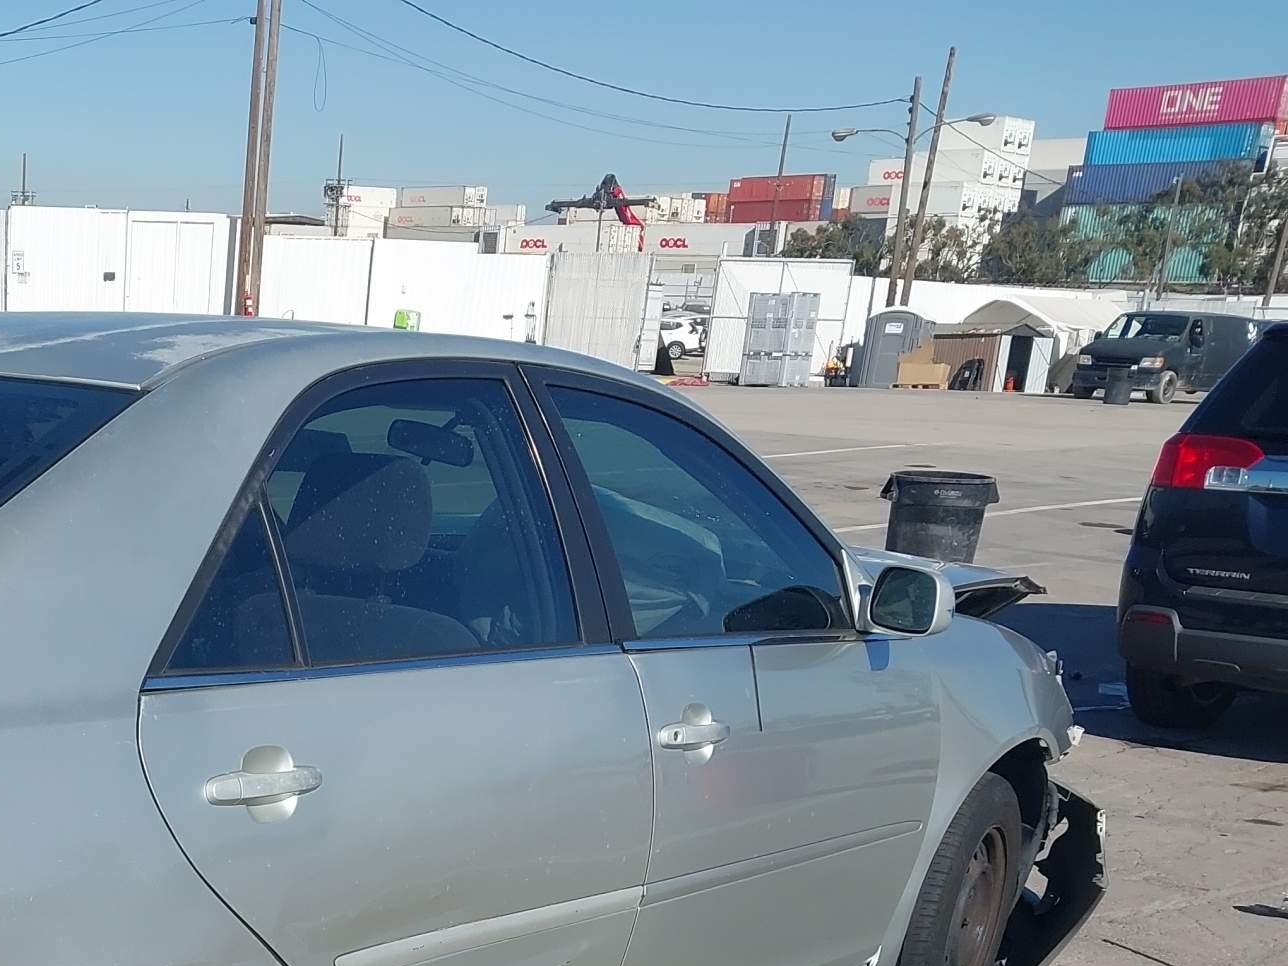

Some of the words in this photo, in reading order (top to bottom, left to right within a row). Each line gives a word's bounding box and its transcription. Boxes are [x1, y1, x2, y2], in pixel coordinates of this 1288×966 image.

[1160, 86, 1223, 113] ONE
[520, 238, 548, 249] OOCL
[659, 237, 689, 249] OOCL
[1187, 567, 1251, 580] TERRAIN
